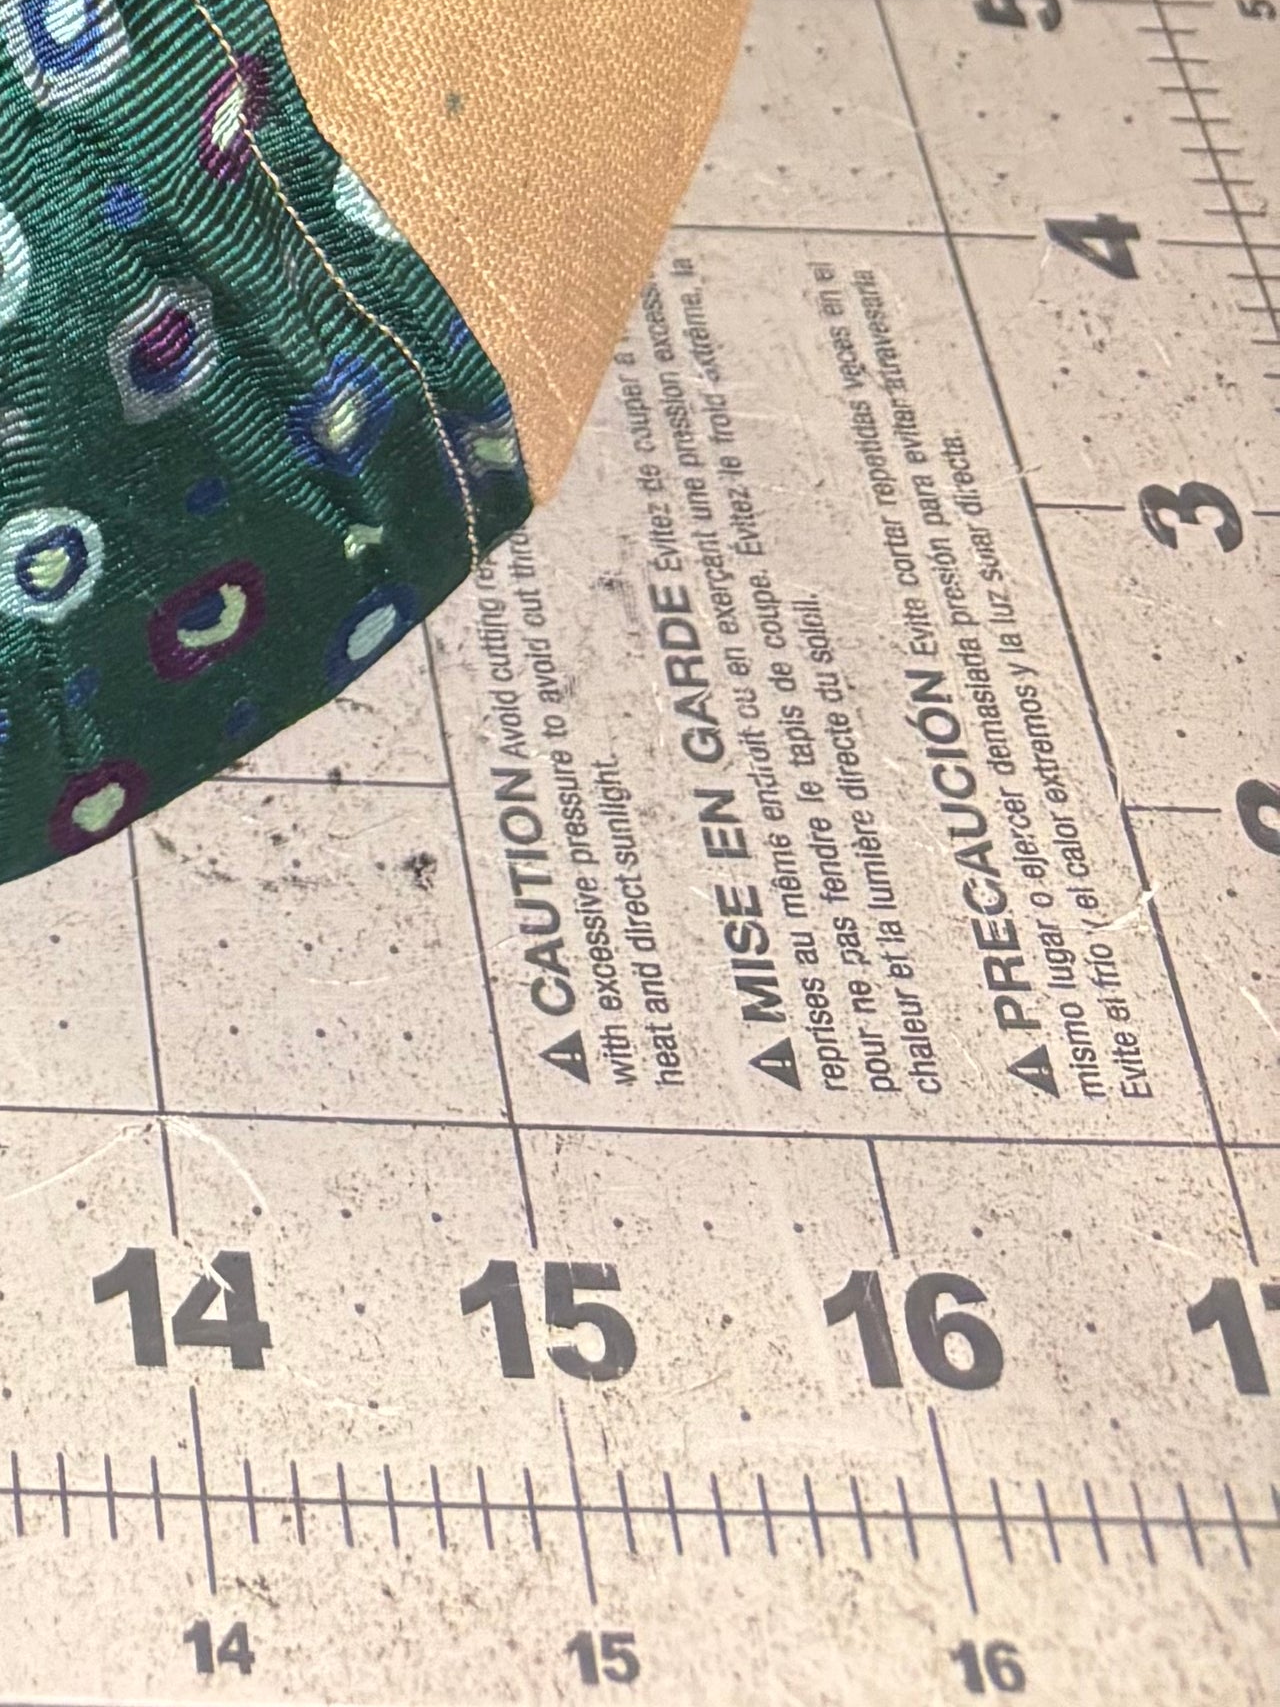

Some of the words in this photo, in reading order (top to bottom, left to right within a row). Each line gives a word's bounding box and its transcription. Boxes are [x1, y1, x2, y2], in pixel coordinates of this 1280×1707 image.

[669, 257, 697, 278] la
[1043, 213, 1140, 278] 4
[818, 289, 845, 318] en
[828, 325, 865, 391] veces
[842, 399, 898, 507] repetidas
[889, 397, 929, 465] evitar
[635, 463, 667, 493] de
[683, 477, 714, 522] une
[910, 474, 952, 527] para
[880, 514, 922, 588] cortar
[1139, 481, 1242, 552] 3
[690, 530, 741, 636] exerçant
[748, 568, 788, 650] coupe.
[924, 537, 981, 628] presión
[986, 590, 1018, 624] luz
[474, 598, 521, 683] cutting
[724, 647, 752, 677] en
[901, 597, 940, 657] Evite
[997, 632, 1027, 654] la
[520, 637, 563, 704] avoid
[647, 583, 726, 765] GARDE
[767, 661, 798, 693] de
[812, 671, 845, 704] du
[487, 689, 530, 760] Avoid
[541, 714, 569, 739] to
[777, 705, 817, 768] tapis
[955, 637, 1016, 776] demasiada
[823, 711, 870, 801] directe
[1014, 684, 1069, 805] extremos
[549, 749, 601, 866] pressure
[590, 752, 640, 867] sunlight.
[692, 787, 752, 860] EN
[996, 785, 1050, 880] ejercer
[762, 832, 809, 919] même
[807, 816, 850, 903] fendre
[850, 809, 898, 910] lumière
[903, 669, 1042, 1033] PRECAUCIÓN
[1049, 810, 1091, 879] calor
[489, 767, 577, 1017] CAUTION
[613, 873, 659, 953] direct
[1029, 891, 1055, 909] o
[572, 876, 624, 1011] excessive
[714, 884, 787, 1024] MISE
[789, 931, 820, 966] au
[832, 916, 872, 966] pas
[875, 920, 906, 944] la
[880, 952, 915, 980] et
[1035, 918, 1078, 990] lugar
[1083, 943, 1122, 989] frío
[630, 961, 671, 1015] and
[847, 979, 877, 1015] ne
[598, 1024, 639, 1086] with
[644, 1022, 685, 1087] heat
[799, 977, 850, 1092] reprises
[857, 1026, 902, 1093] pour
[894, 986, 943, 1096] chaleur
[1059, 1001, 1107, 1100] mismo
[1111, 1031, 1155, 1099] Evite
[91, 1247, 273, 1370] 14
[460, 1259, 638, 1382] 15
[824, 1269, 1004, 1390] 16
[1187, 1278, 1280, 1396] 1
[183, 1620, 255, 1675] 14
[564, 1632, 640, 1686] 15
[949, 1640, 1026, 1693] 16
